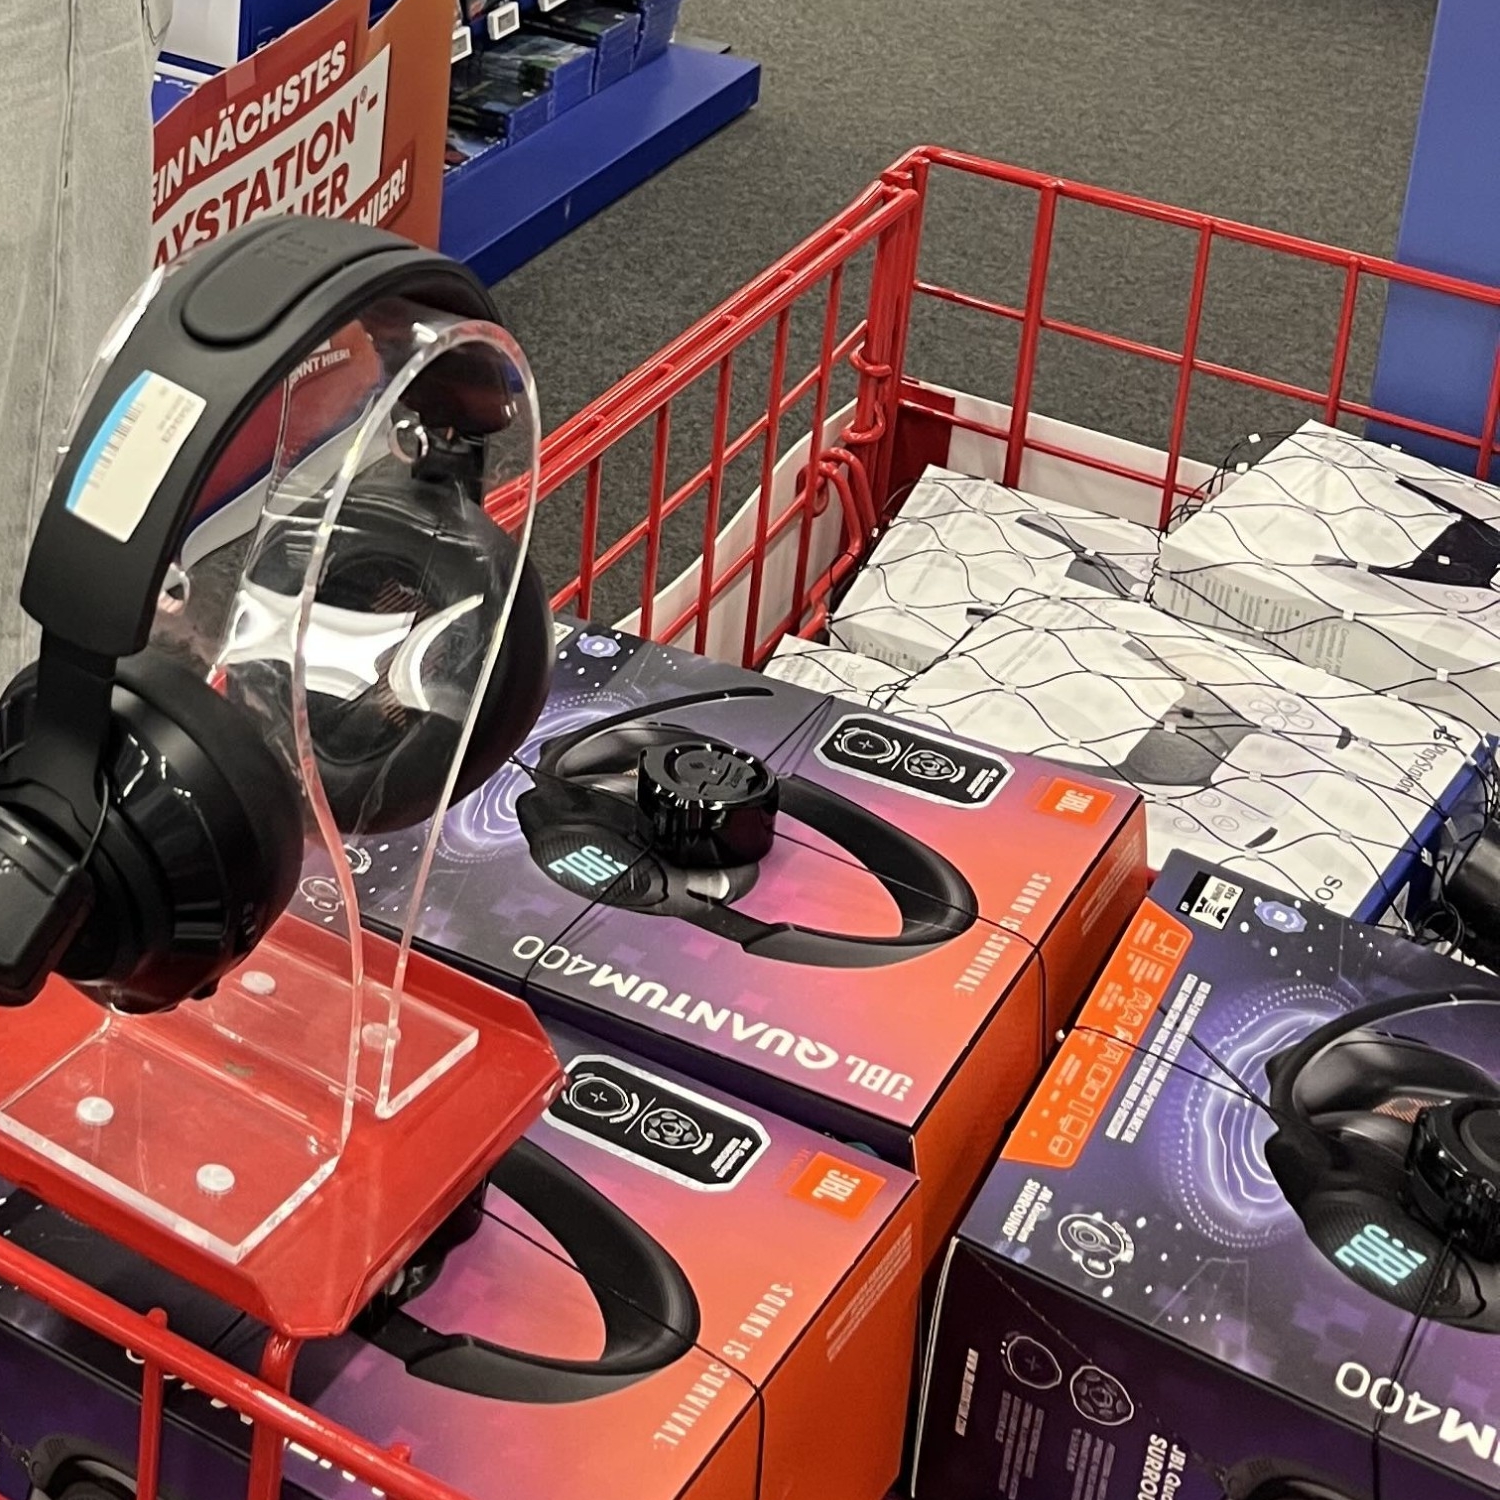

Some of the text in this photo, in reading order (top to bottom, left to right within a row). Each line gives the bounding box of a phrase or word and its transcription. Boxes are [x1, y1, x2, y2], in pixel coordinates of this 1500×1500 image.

[187, 40, 347, 177] NÄCHSTES
[1054, 788, 1095, 814] JBL
[547, 843, 630, 887] JBL
[1010, 871, 1052, 916] SOUND
[953, 932, 1012, 995] SURVIVAL
[845, 1053, 914, 1101] JBL
[811, 1168, 862, 1204] JBL
[1037, 1186, 1054, 1204] JBL
[1334, 1224, 1429, 1287] JBL
[653, 1282, 794, 1448] SOUND IS SURVIVAL
[1167, 1443, 1187, 1473] JBL
